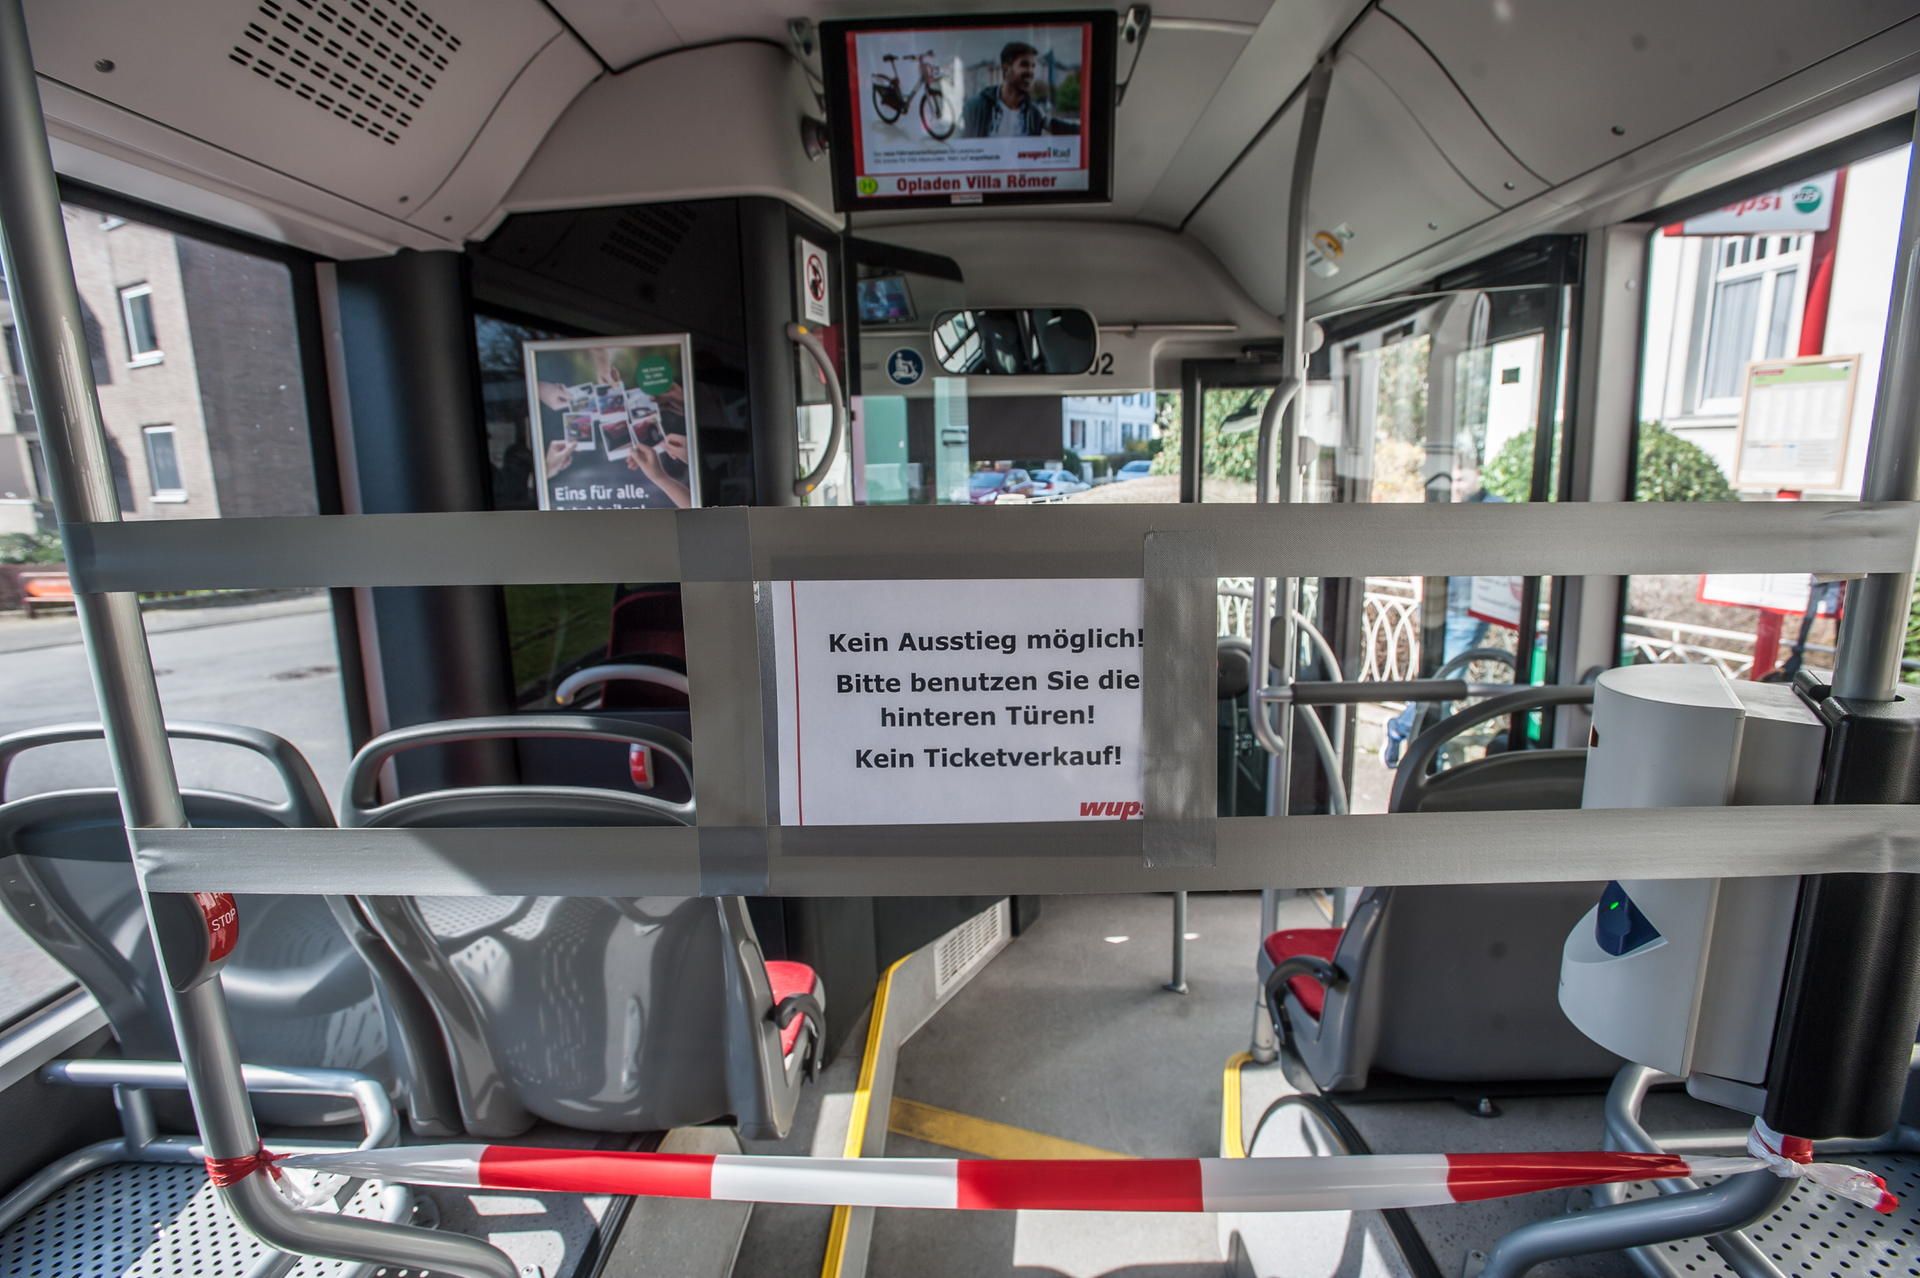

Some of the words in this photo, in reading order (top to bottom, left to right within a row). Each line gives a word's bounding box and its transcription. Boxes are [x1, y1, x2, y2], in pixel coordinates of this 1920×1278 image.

[896, 177, 961, 194] Opladen
[966, 176, 1001, 189] Villa
[1007, 174, 1057, 188] Römer
[555, 486, 587, 501] Eins
[590, 485, 613, 499] für
[616, 484, 649, 499] alle.
[828, 632, 889, 653] Kein
[897, 630, 1017, 655] Ausstieg
[1027, 628, 1144, 654] möglich!
[836, 673, 901, 694] Bitte
[910, 672, 1038, 693] benutzen
[1047, 669, 1089, 691] Sie
[1098, 669, 1140, 690] die
[880, 706, 996, 728] hinteren
[1004, 704, 1095, 726] Türen!
[855, 748, 915, 769] Kein
[923, 745, 1122, 768] Ticketverkauf!
[1080, 801, 1144, 822] wup
[211, 908, 236, 931] STOP
